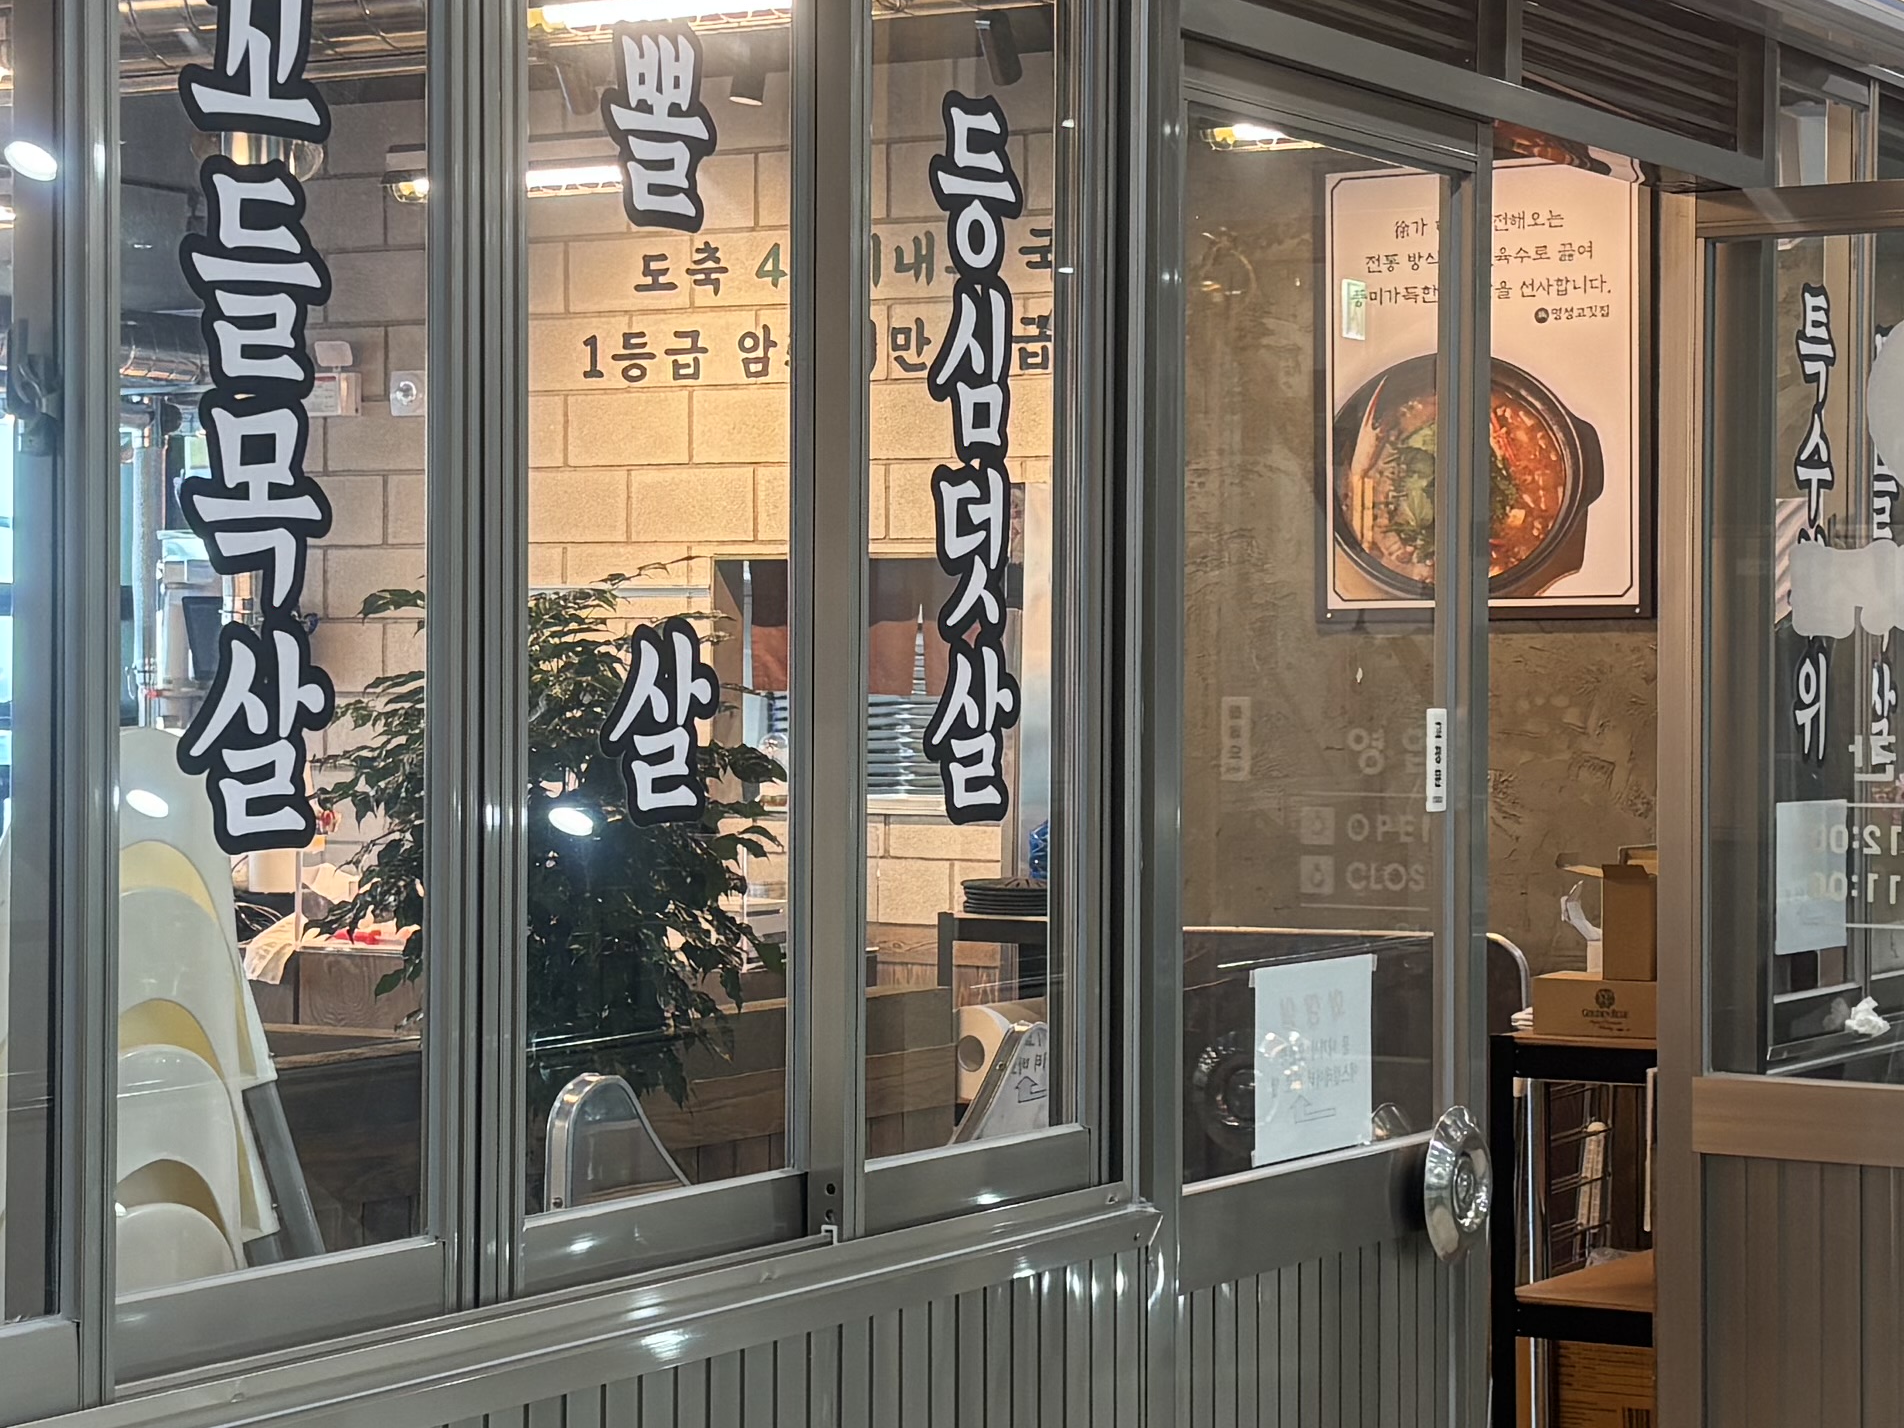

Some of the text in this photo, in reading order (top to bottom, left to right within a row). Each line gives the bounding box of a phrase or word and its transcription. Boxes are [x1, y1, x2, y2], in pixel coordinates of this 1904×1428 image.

[633, 240, 729, 297] 도축
[1494, 244, 1551, 264] 육수로
[1557, 240, 1593, 262] 끓여
[1519, 274, 1612, 299] 선사합니다.
[1550, 304, 1610, 321] 명성고깃집
[582, 329, 709, 383] 1등급
[925, 90, 1023, 825] 등심덧살
